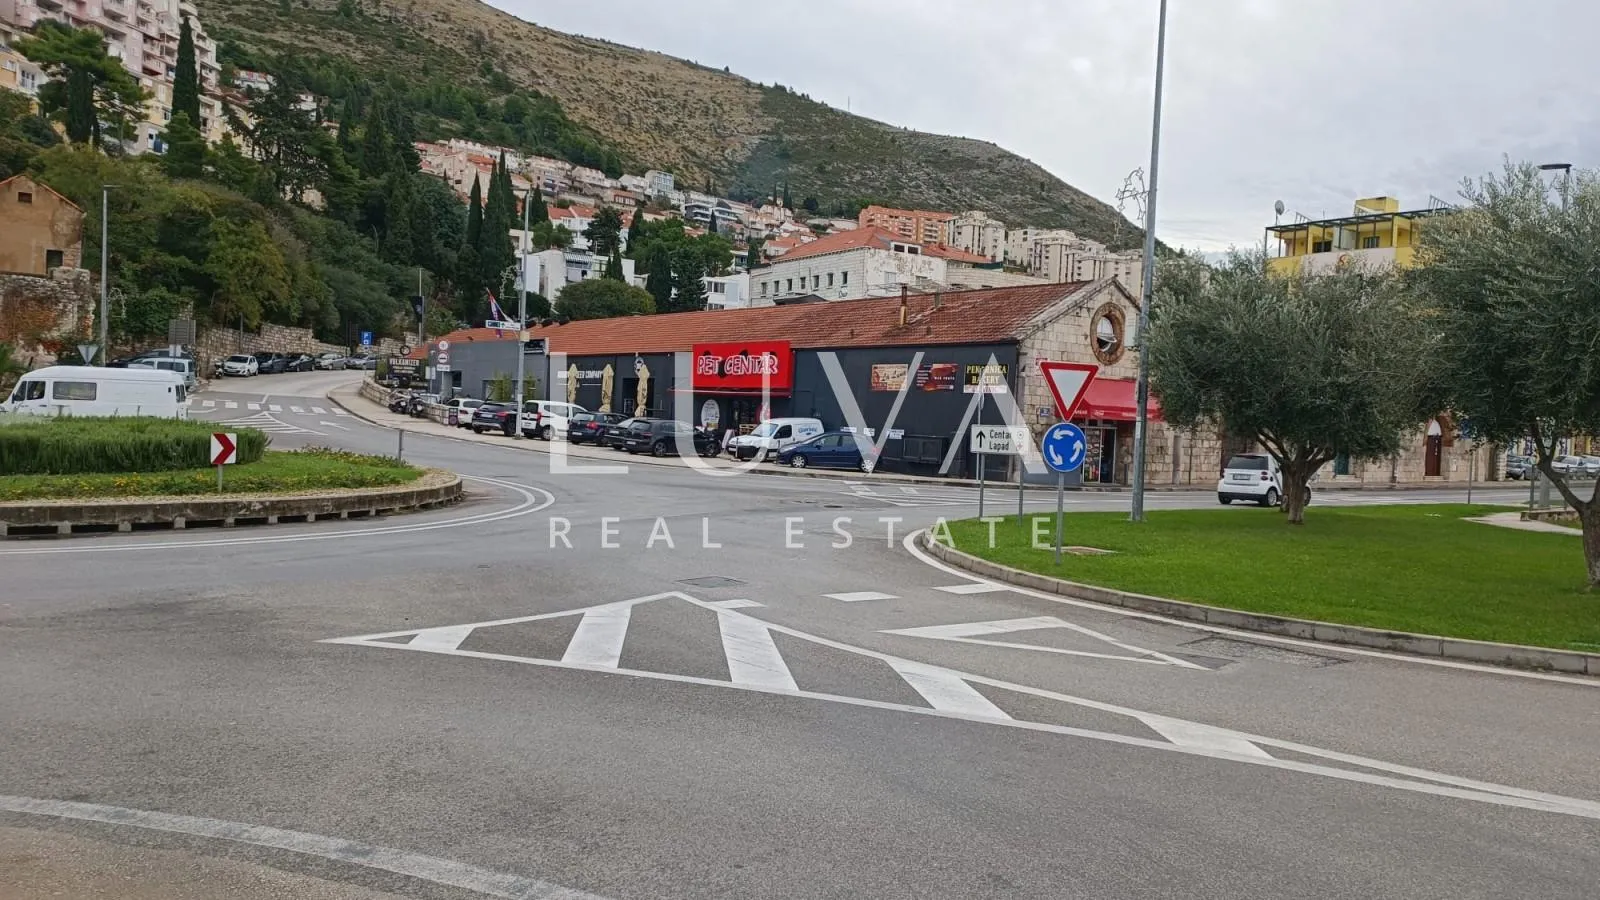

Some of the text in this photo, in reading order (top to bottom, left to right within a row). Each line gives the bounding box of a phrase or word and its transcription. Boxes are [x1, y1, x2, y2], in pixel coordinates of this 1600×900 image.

[697, 355, 778, 375] PET CENTAR
[989, 440, 1009, 452] Lapad
